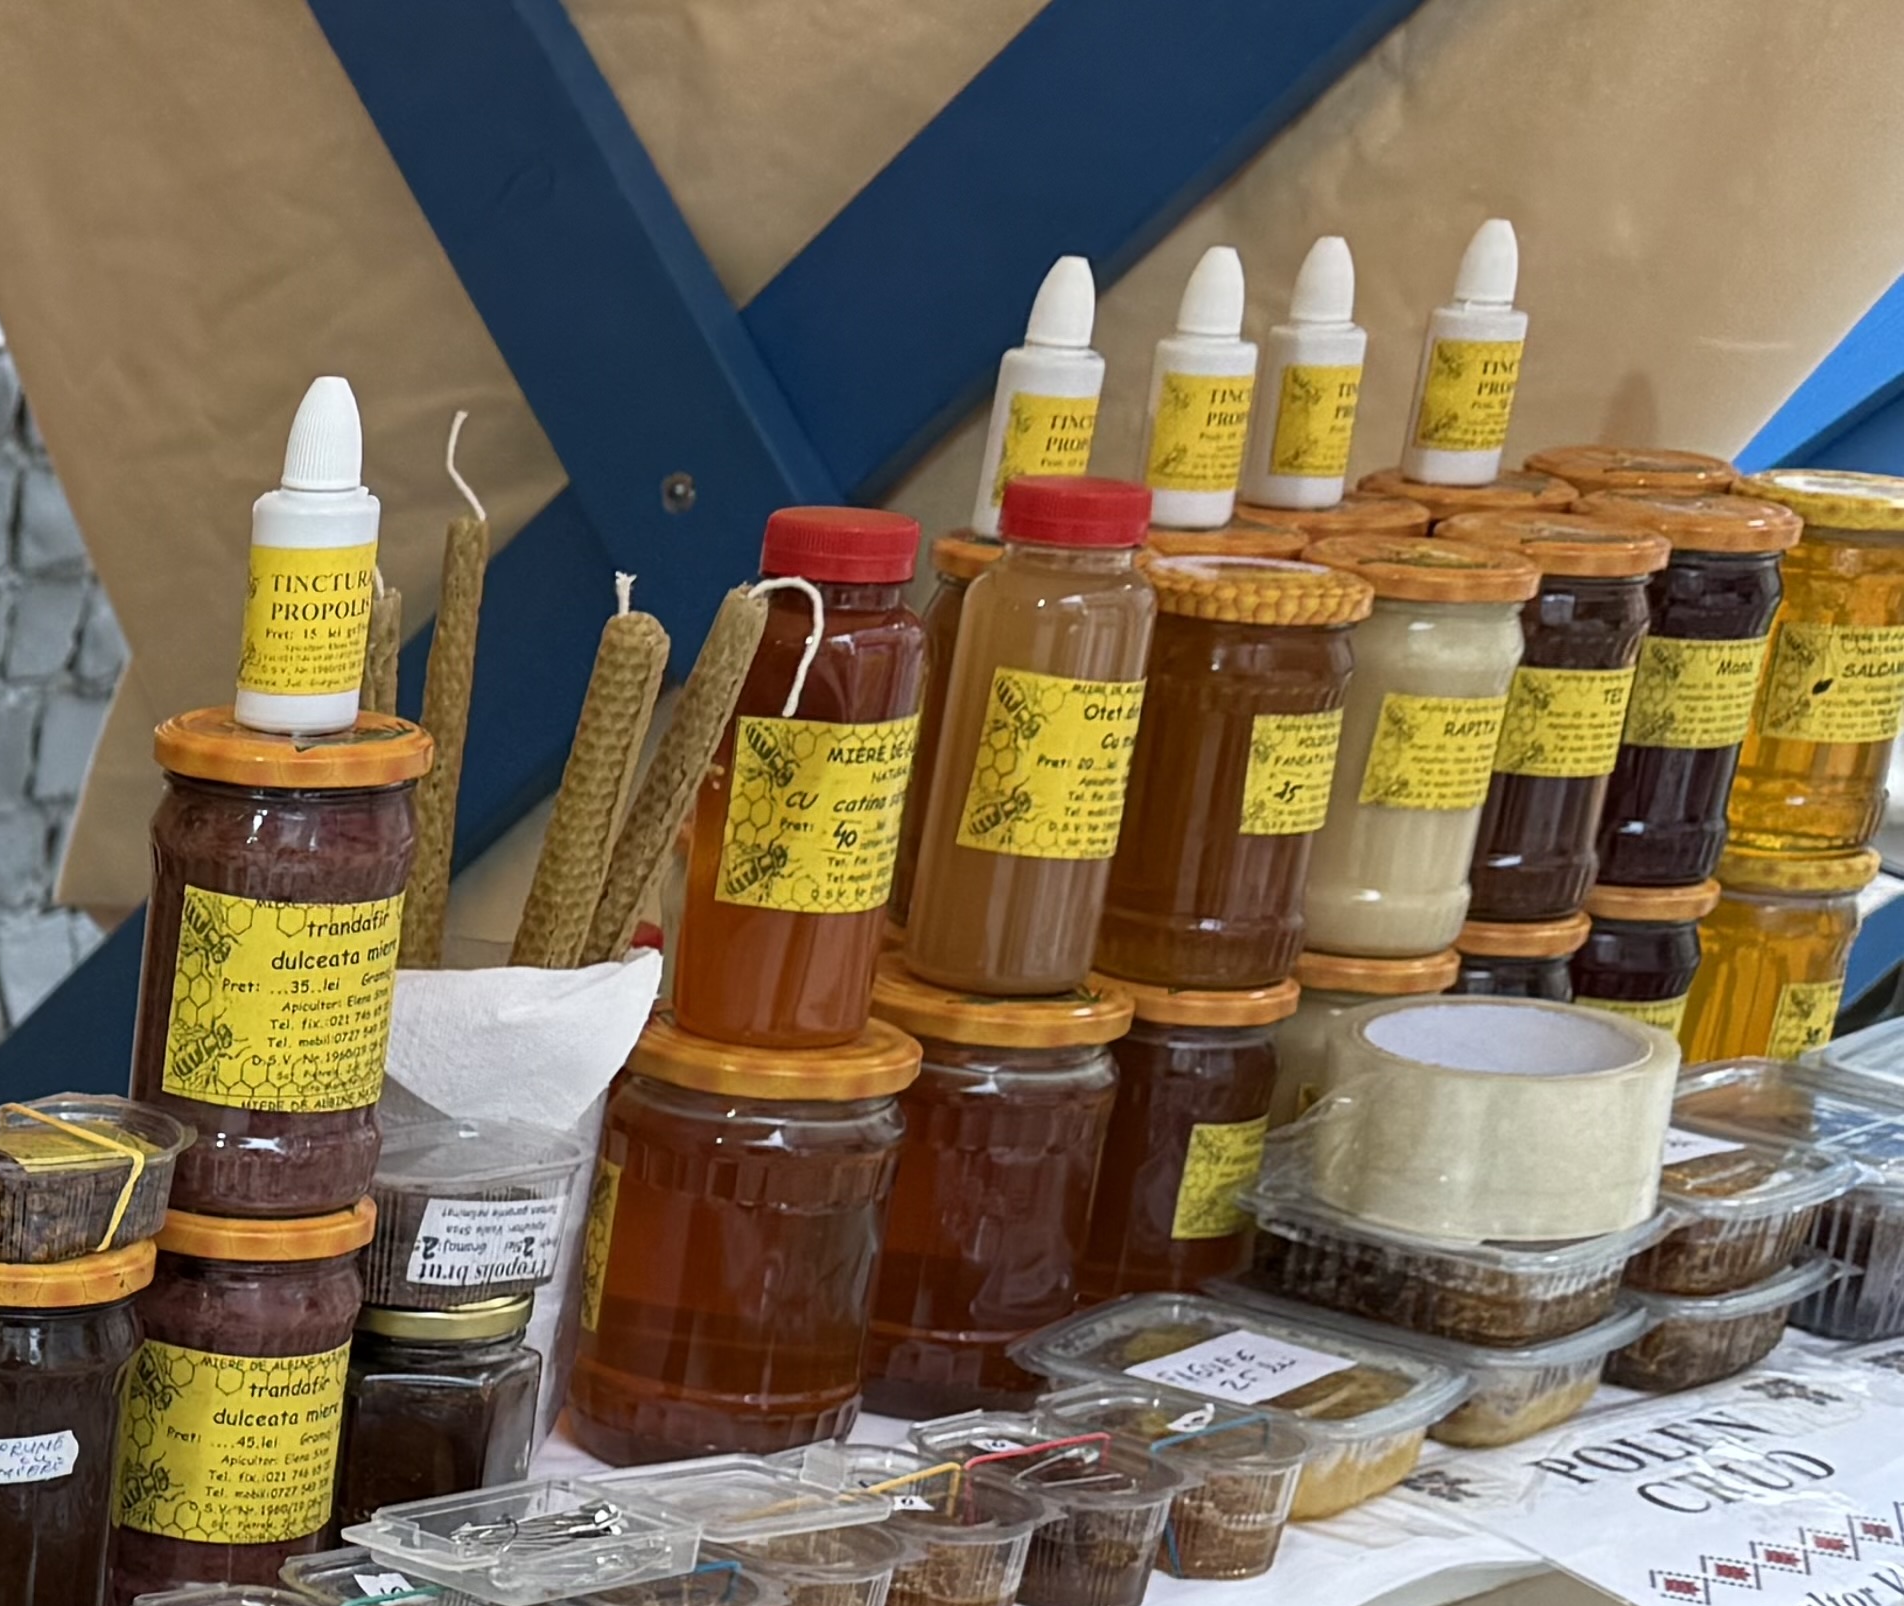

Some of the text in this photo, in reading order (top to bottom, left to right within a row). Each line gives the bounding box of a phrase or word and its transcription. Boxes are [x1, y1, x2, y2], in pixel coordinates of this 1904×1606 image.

[307, 909, 390, 938] trandafir
[272, 948, 360, 971] dulceata
[249, 1376, 330, 1398] trandafir
[213, 1408, 298, 1427] dulceata
[1522, 1411, 1783, 1485] POLEN
[1637, 1449, 1836, 1515] CRUD
